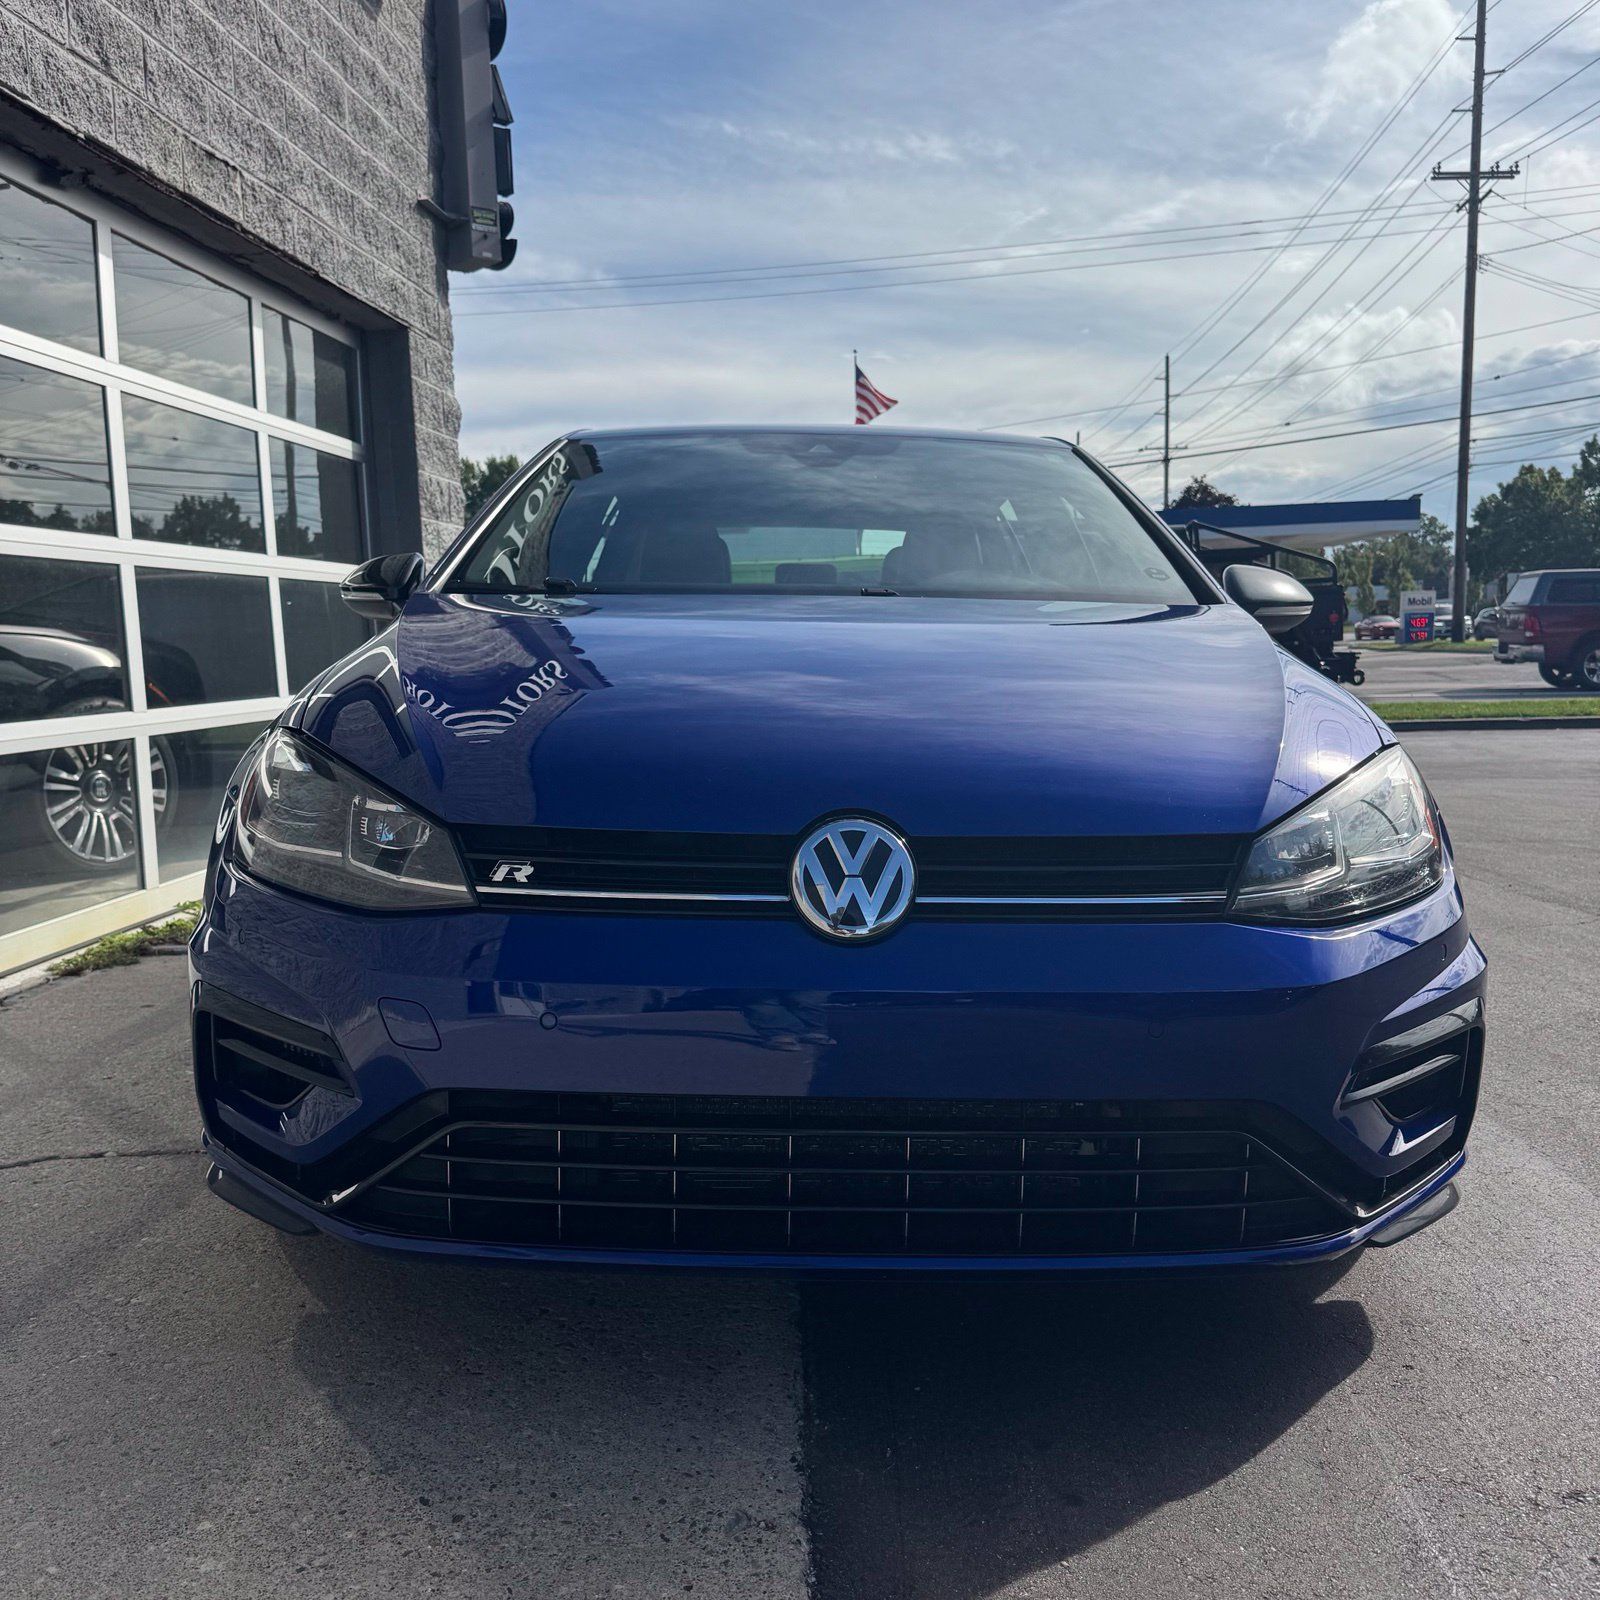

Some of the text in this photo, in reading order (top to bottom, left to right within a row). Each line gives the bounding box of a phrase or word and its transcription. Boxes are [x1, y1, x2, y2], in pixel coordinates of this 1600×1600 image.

[1407, 597, 1432, 606] Mobil
[489, 859, 535, 883] R
[796, 822, 914, 936] VW
